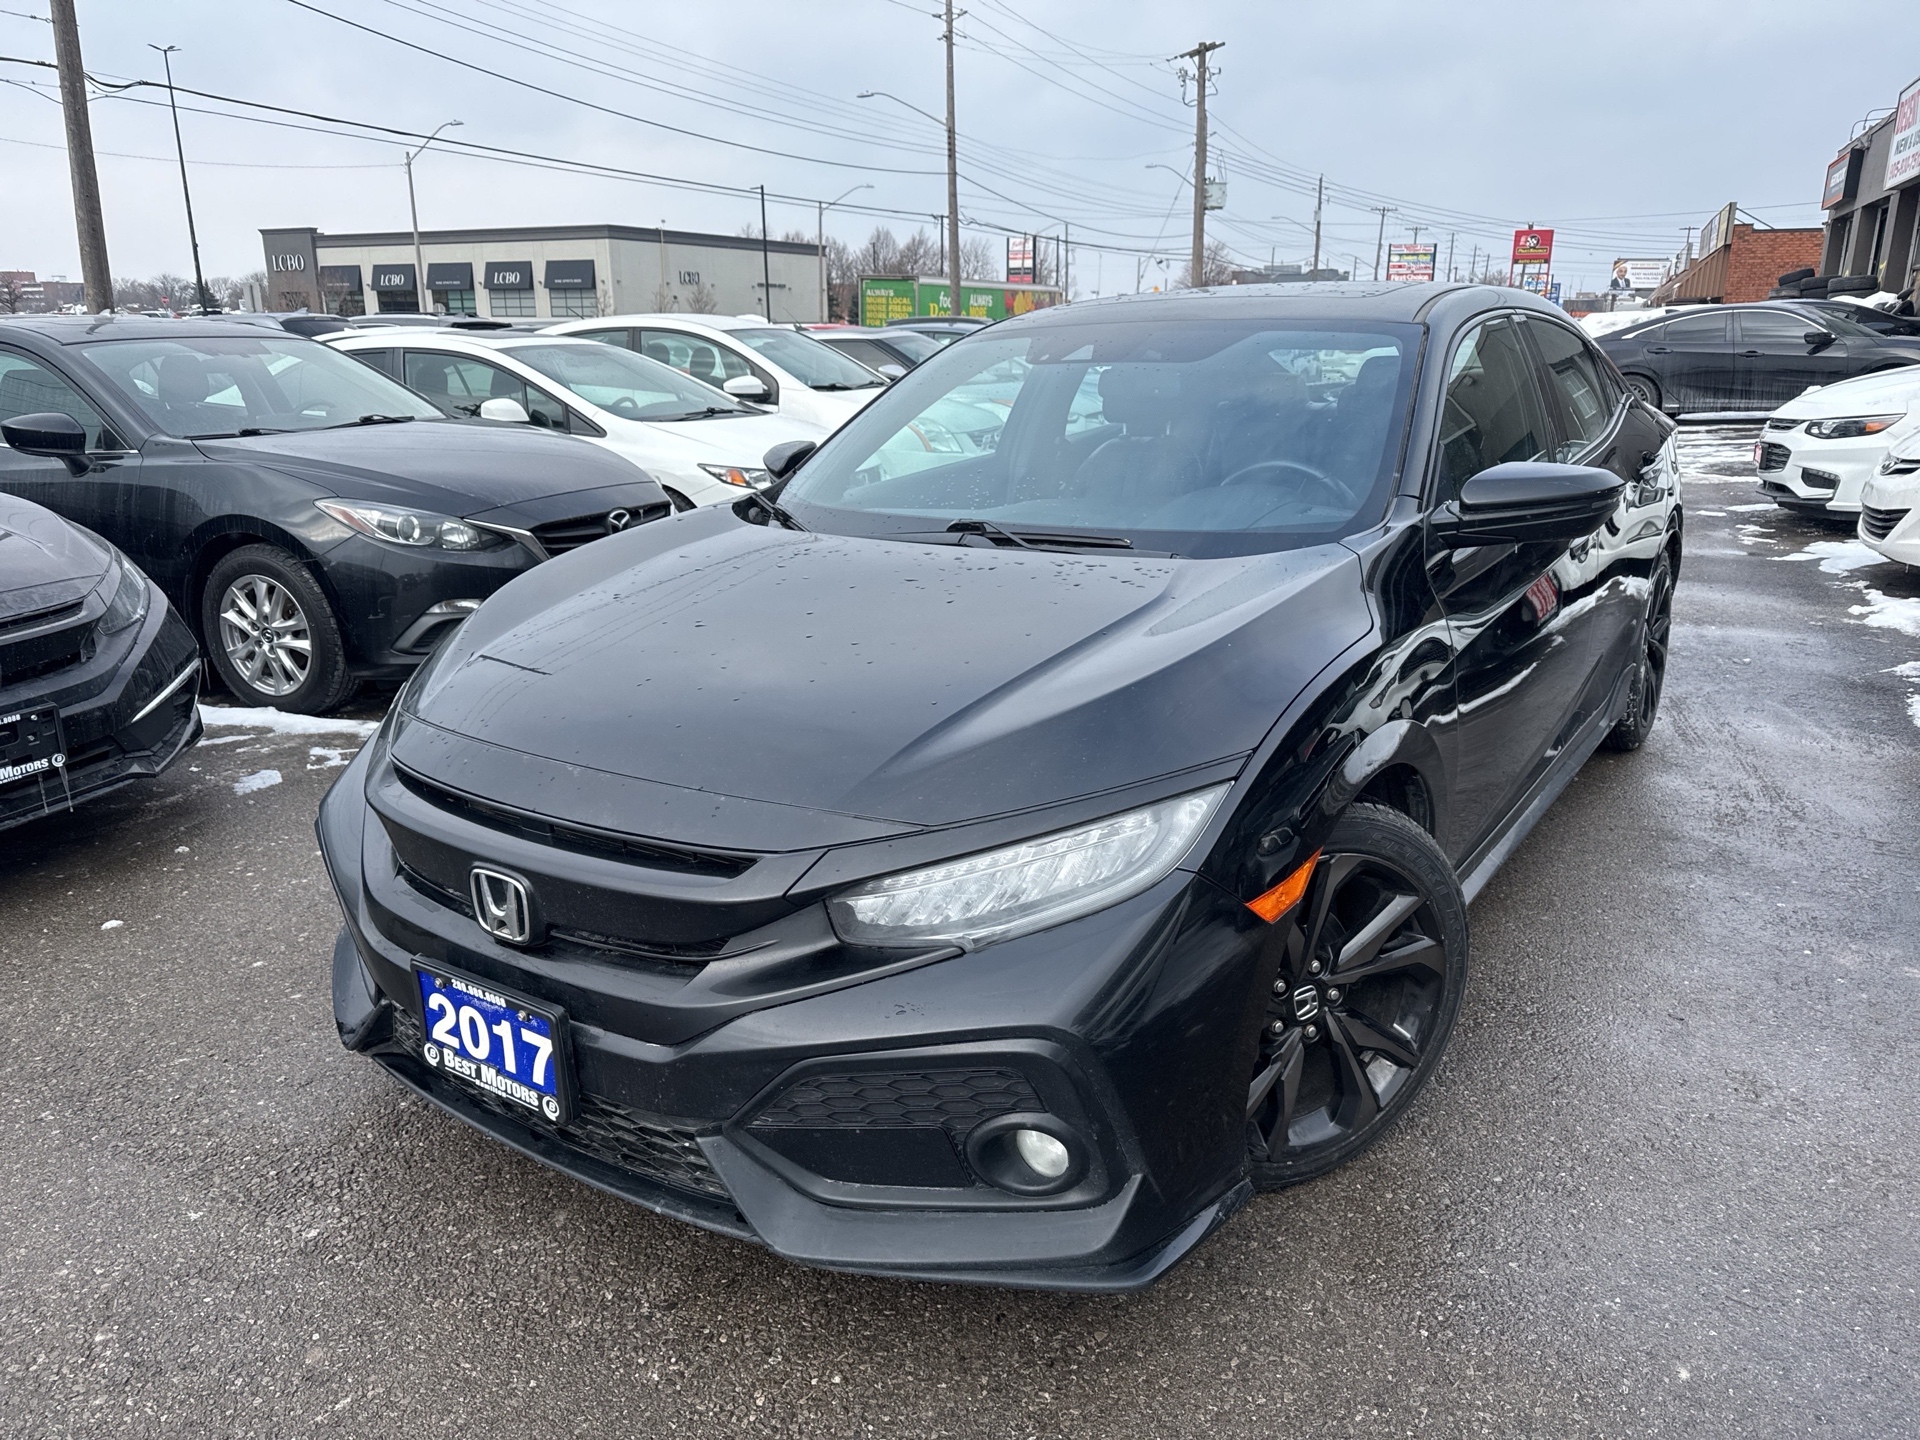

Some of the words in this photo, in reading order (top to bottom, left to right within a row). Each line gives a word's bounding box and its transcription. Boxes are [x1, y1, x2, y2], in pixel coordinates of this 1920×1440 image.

[272, 254, 305, 272] LCBO
[380, 274, 404, 286] LCBO
[494, 272, 520, 284] LCBO
[679, 271, 700, 285] LCBO
[969, 294, 993, 307] ALWAYS
[429, 993, 553, 1086] 2017
[443, 1048, 477, 1078] BEST
[481, 1064, 540, 1107] MOTORS
